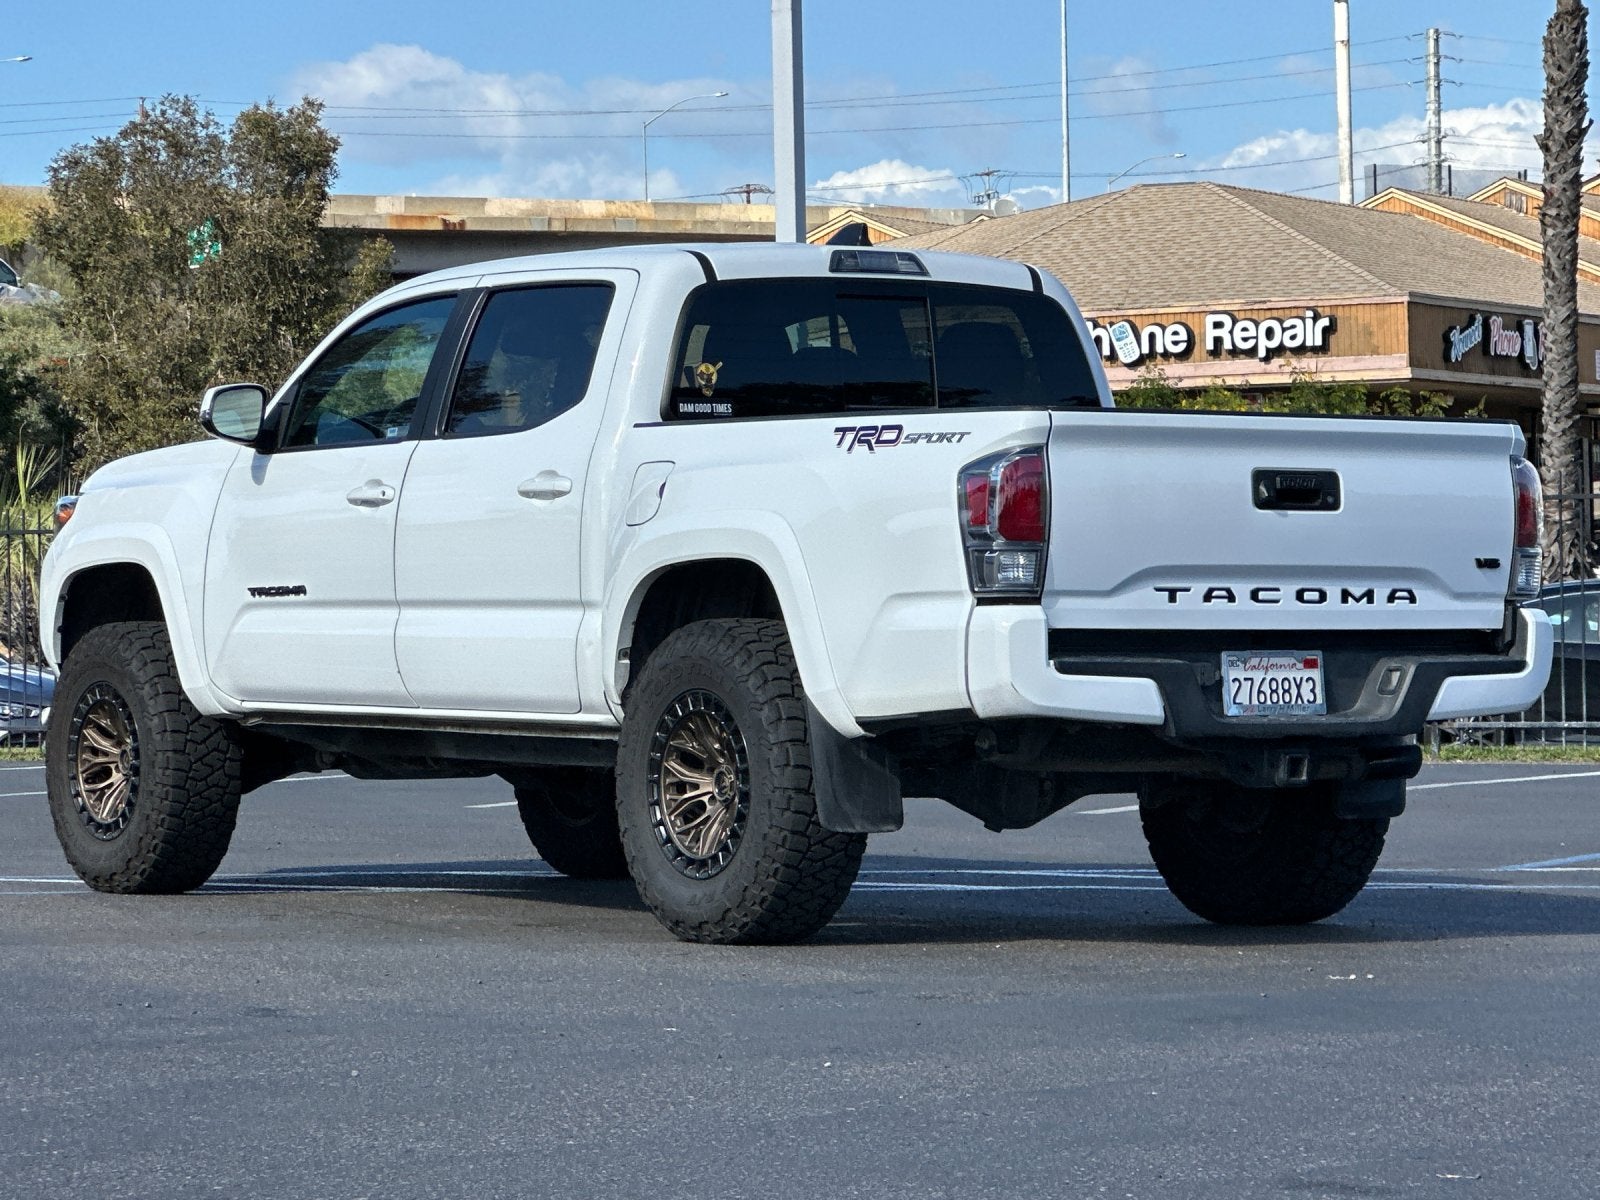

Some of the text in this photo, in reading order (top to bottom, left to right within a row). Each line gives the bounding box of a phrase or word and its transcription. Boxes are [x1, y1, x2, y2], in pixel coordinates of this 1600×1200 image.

[1205, 310, 1330, 359] Repair
[1489, 315, 1522, 357] Phone
[679, 403, 732, 413] DAM GOOD TIMES
[834, 424, 972, 454] TRD SPORT
[1153, 586, 1418, 604] TACOMA
[1243, 657, 1304, 675] California
[1231, 676, 1317, 705] 27688X3
